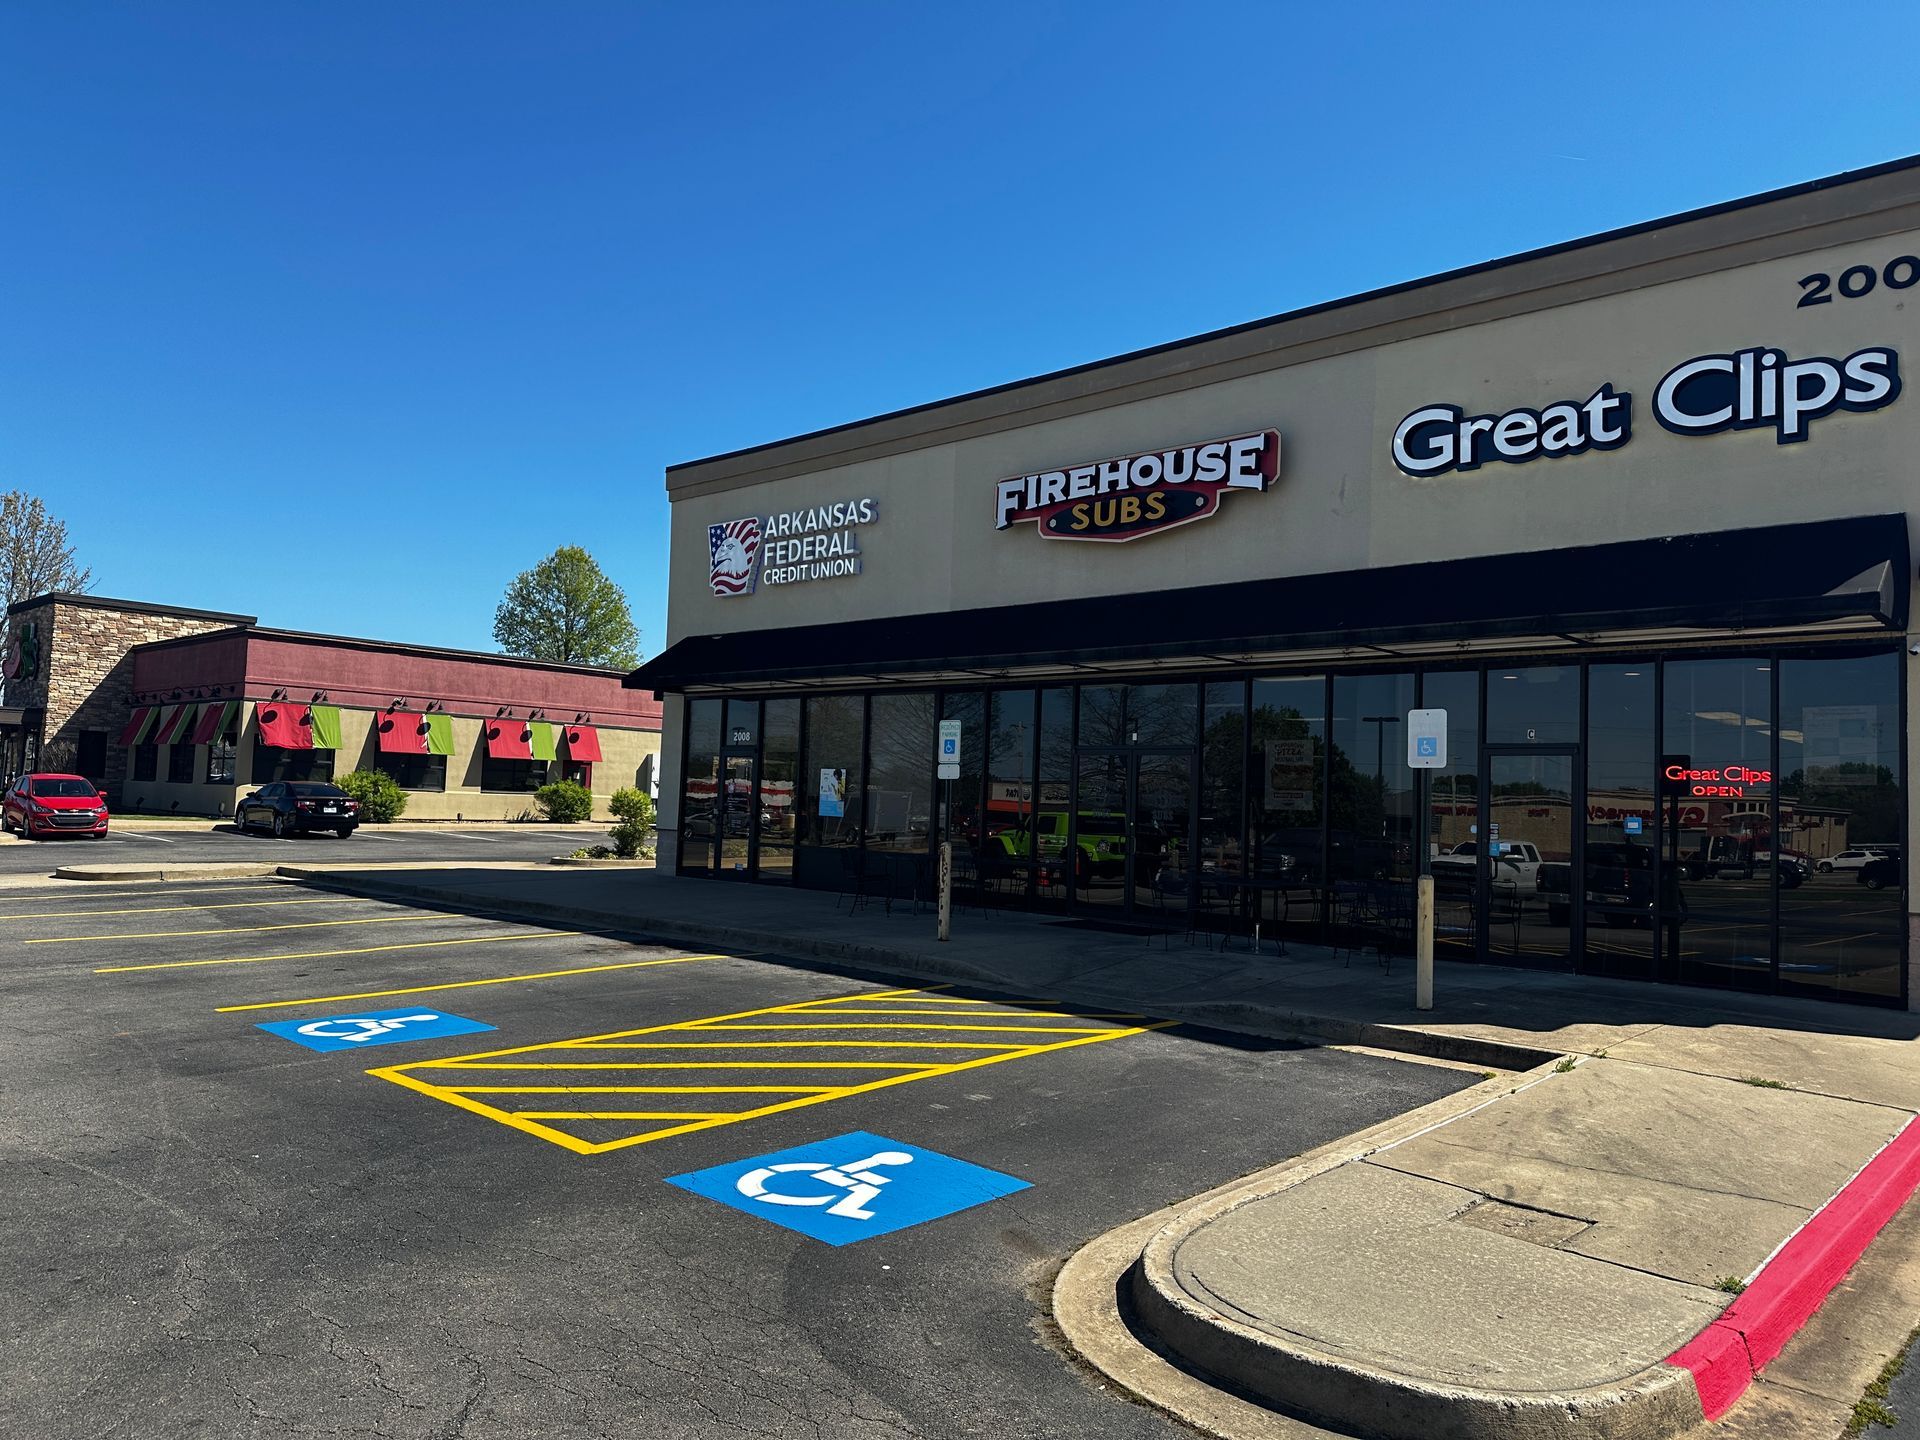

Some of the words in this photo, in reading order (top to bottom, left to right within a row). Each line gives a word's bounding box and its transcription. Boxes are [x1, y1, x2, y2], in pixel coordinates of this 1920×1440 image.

[1797, 255, 1920, 309] 200
[1392, 389, 1624, 471] Great
[1656, 350, 1892, 434] Clips
[996, 432, 1265, 530] FIREHOUSE
[764, 498, 872, 539] ARKANSAS
[1070, 491, 1166, 531] SUBS
[763, 530, 854, 567] FEDERAL
[763, 564, 808, 585] CREDIT
[811, 557, 855, 580] UNION
[733, 731, 751, 741] 2008
[1528, 729, 1534, 739] C
[1665, 765, 1720, 781] Great
[1723, 766, 1772, 786] Clips
[1692, 786, 1744, 797] OPEN
